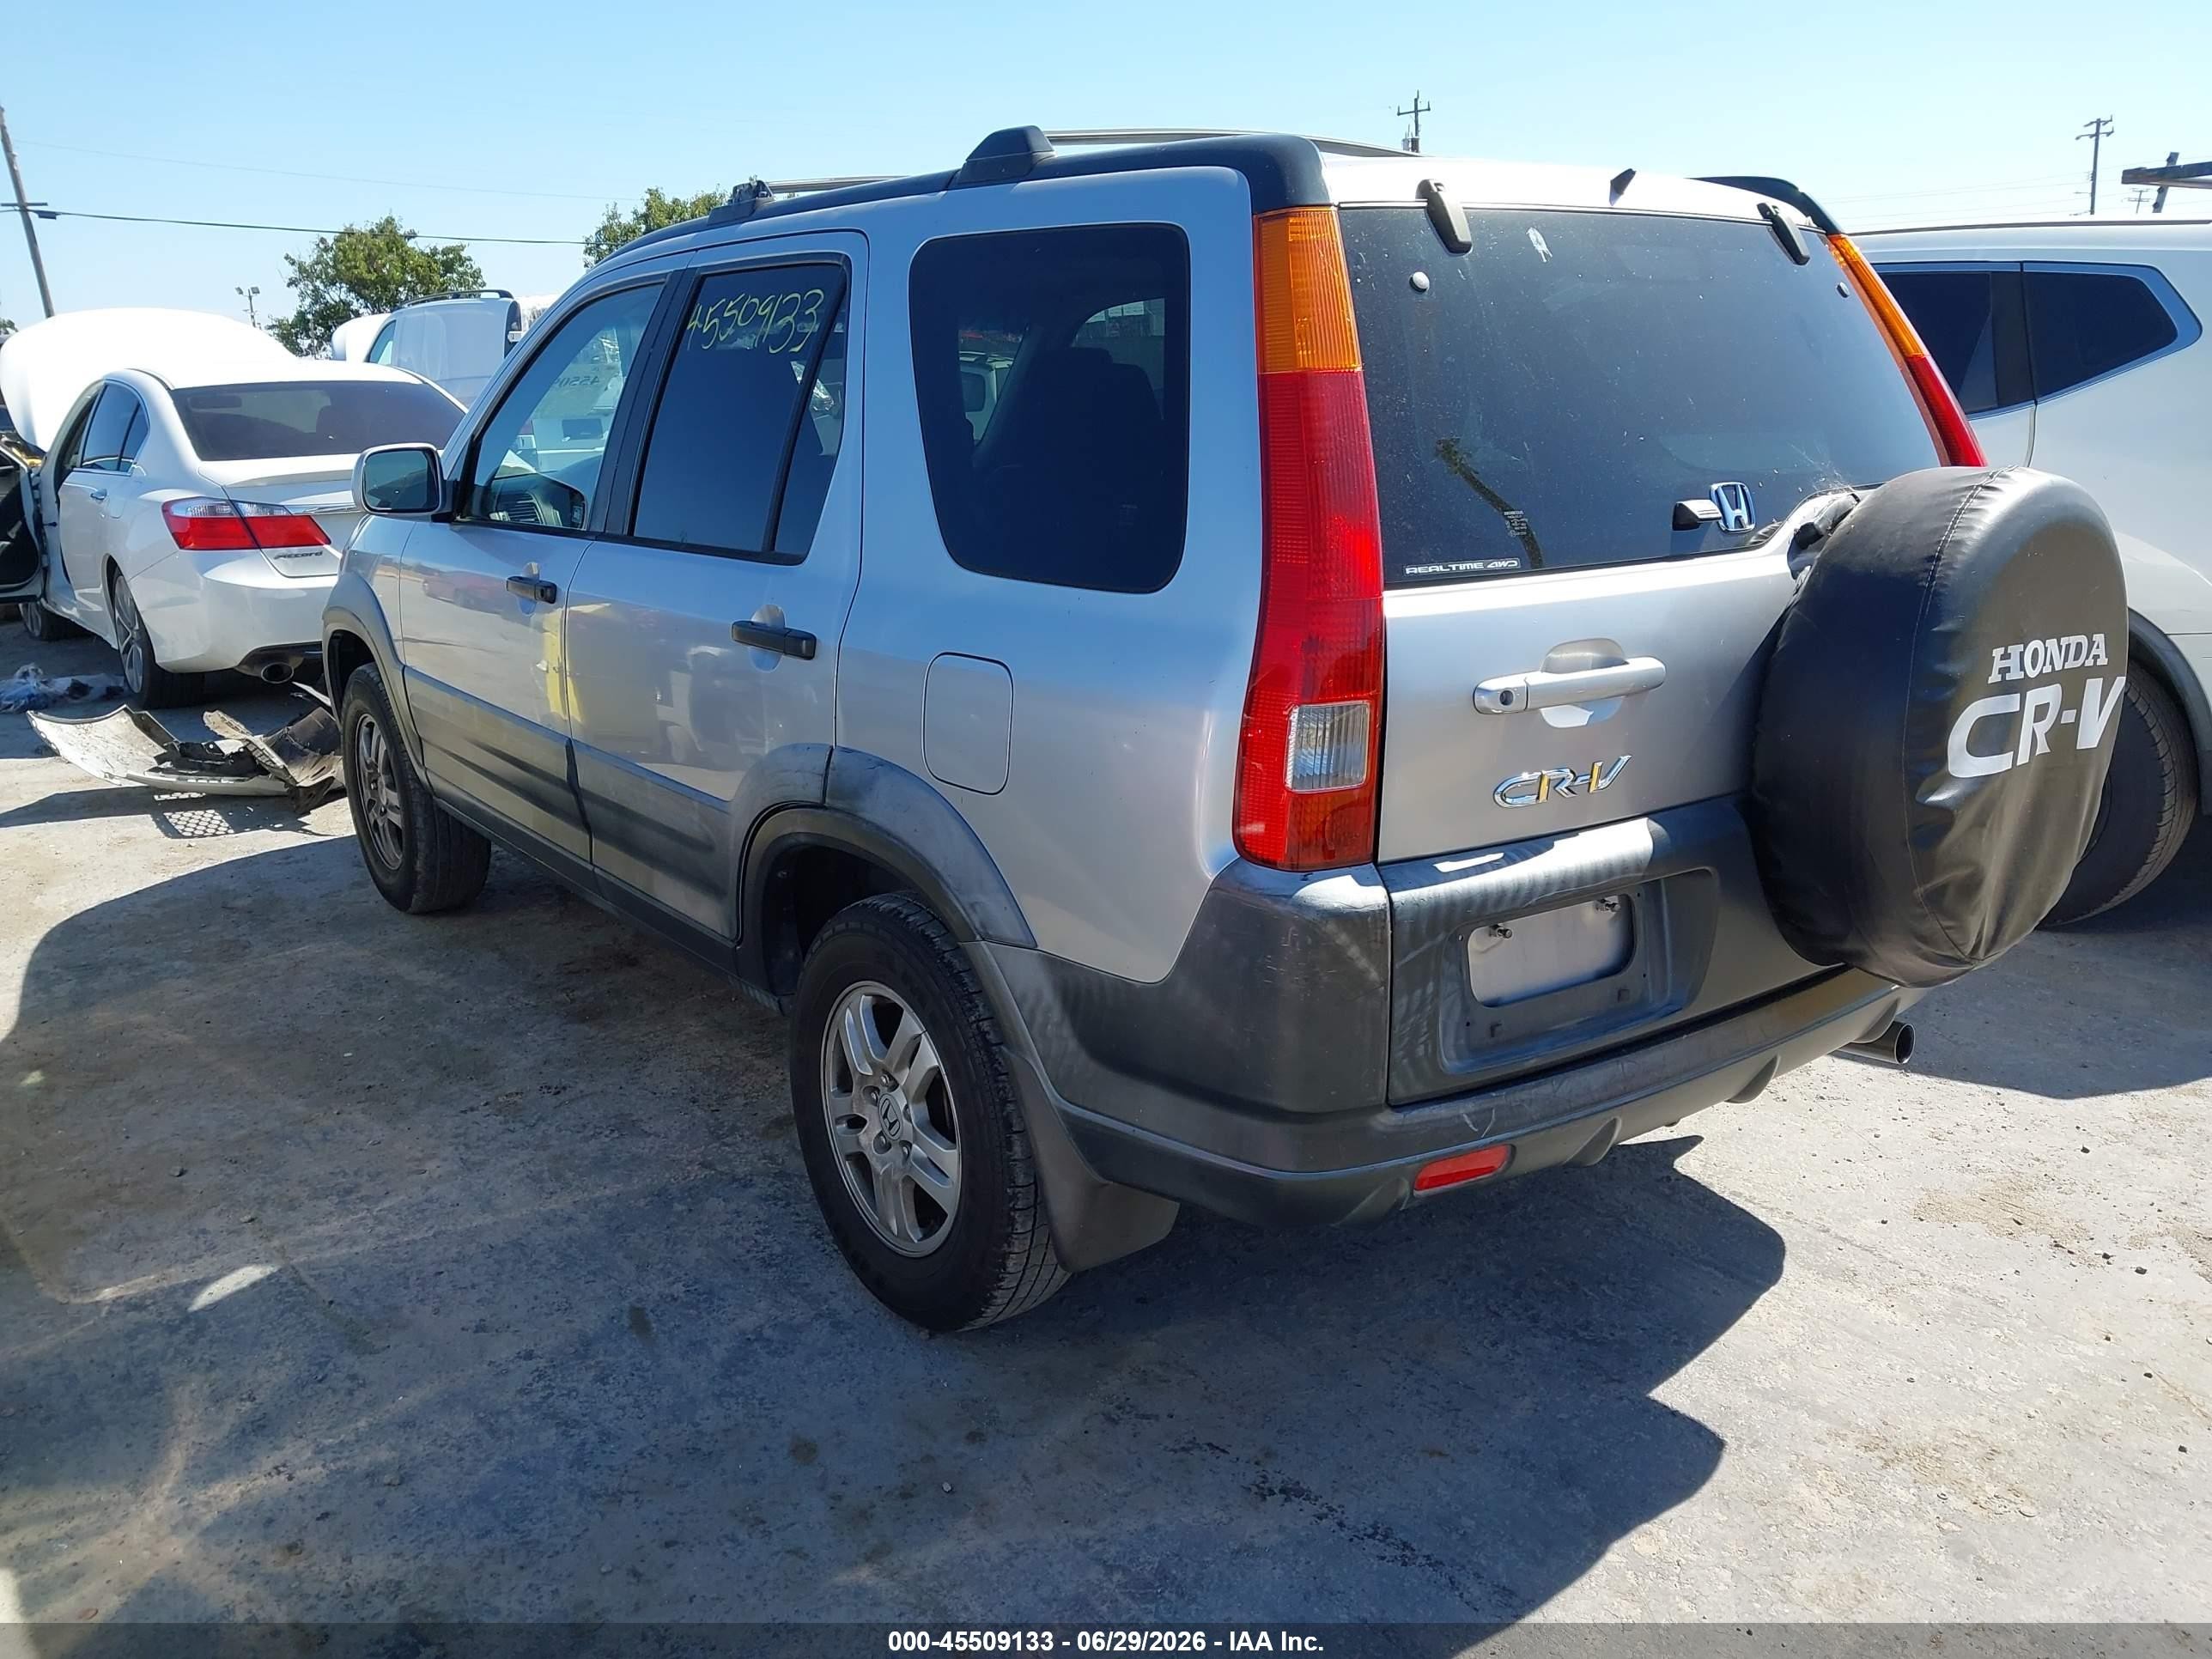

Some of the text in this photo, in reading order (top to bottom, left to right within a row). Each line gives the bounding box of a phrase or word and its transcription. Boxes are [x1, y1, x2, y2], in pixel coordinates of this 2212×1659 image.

[688, 289, 824, 353] 45509133
[1987, 633, 2109, 684] HONDA
[1947, 675, 2127, 779] CR-V
[1492, 754, 1632, 809] CR-V
